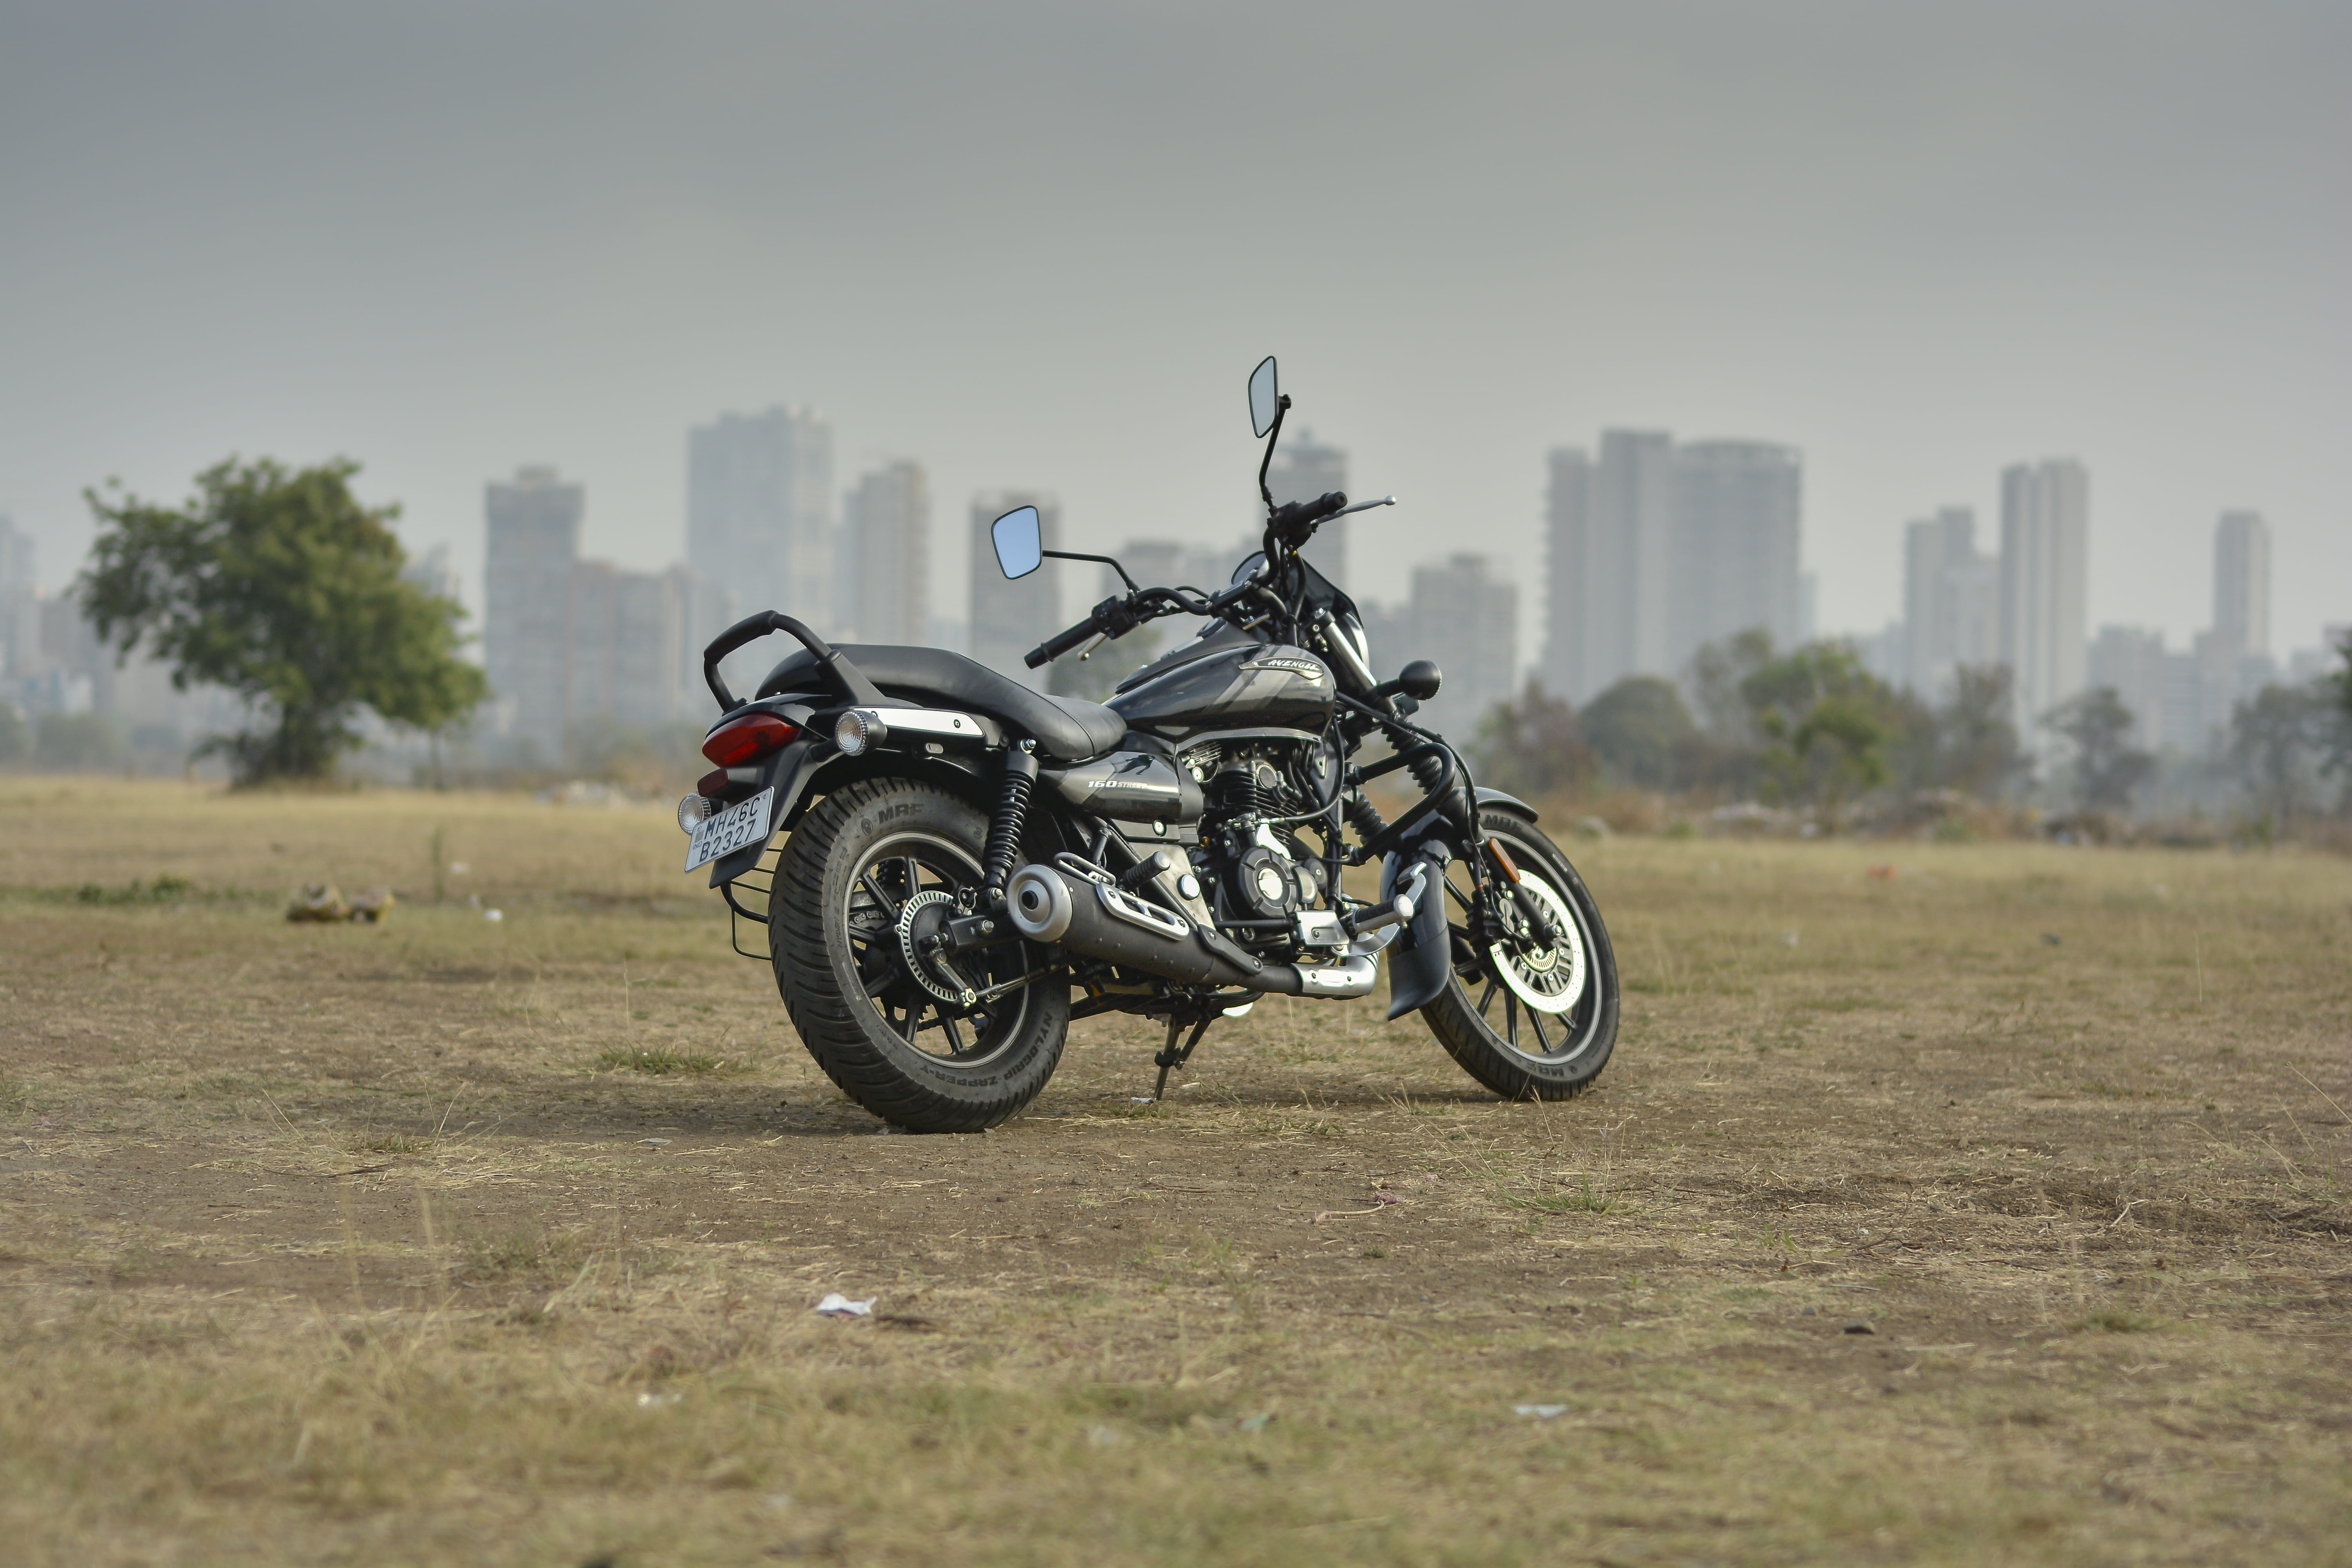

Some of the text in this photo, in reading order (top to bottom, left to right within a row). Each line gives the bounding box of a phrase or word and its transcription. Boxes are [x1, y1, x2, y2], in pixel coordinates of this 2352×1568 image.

[1268, 660, 1319, 671] AVENGER
[704, 797, 760, 840] MH46C
[878, 804, 924, 824] MRF
[1485, 814, 1524, 829] MRF
[693, 841, 702, 850] IND
[699, 818, 757, 862] B2327
[920, 1012, 1053, 1087] NYLOGRIP ZAPPER-Y
